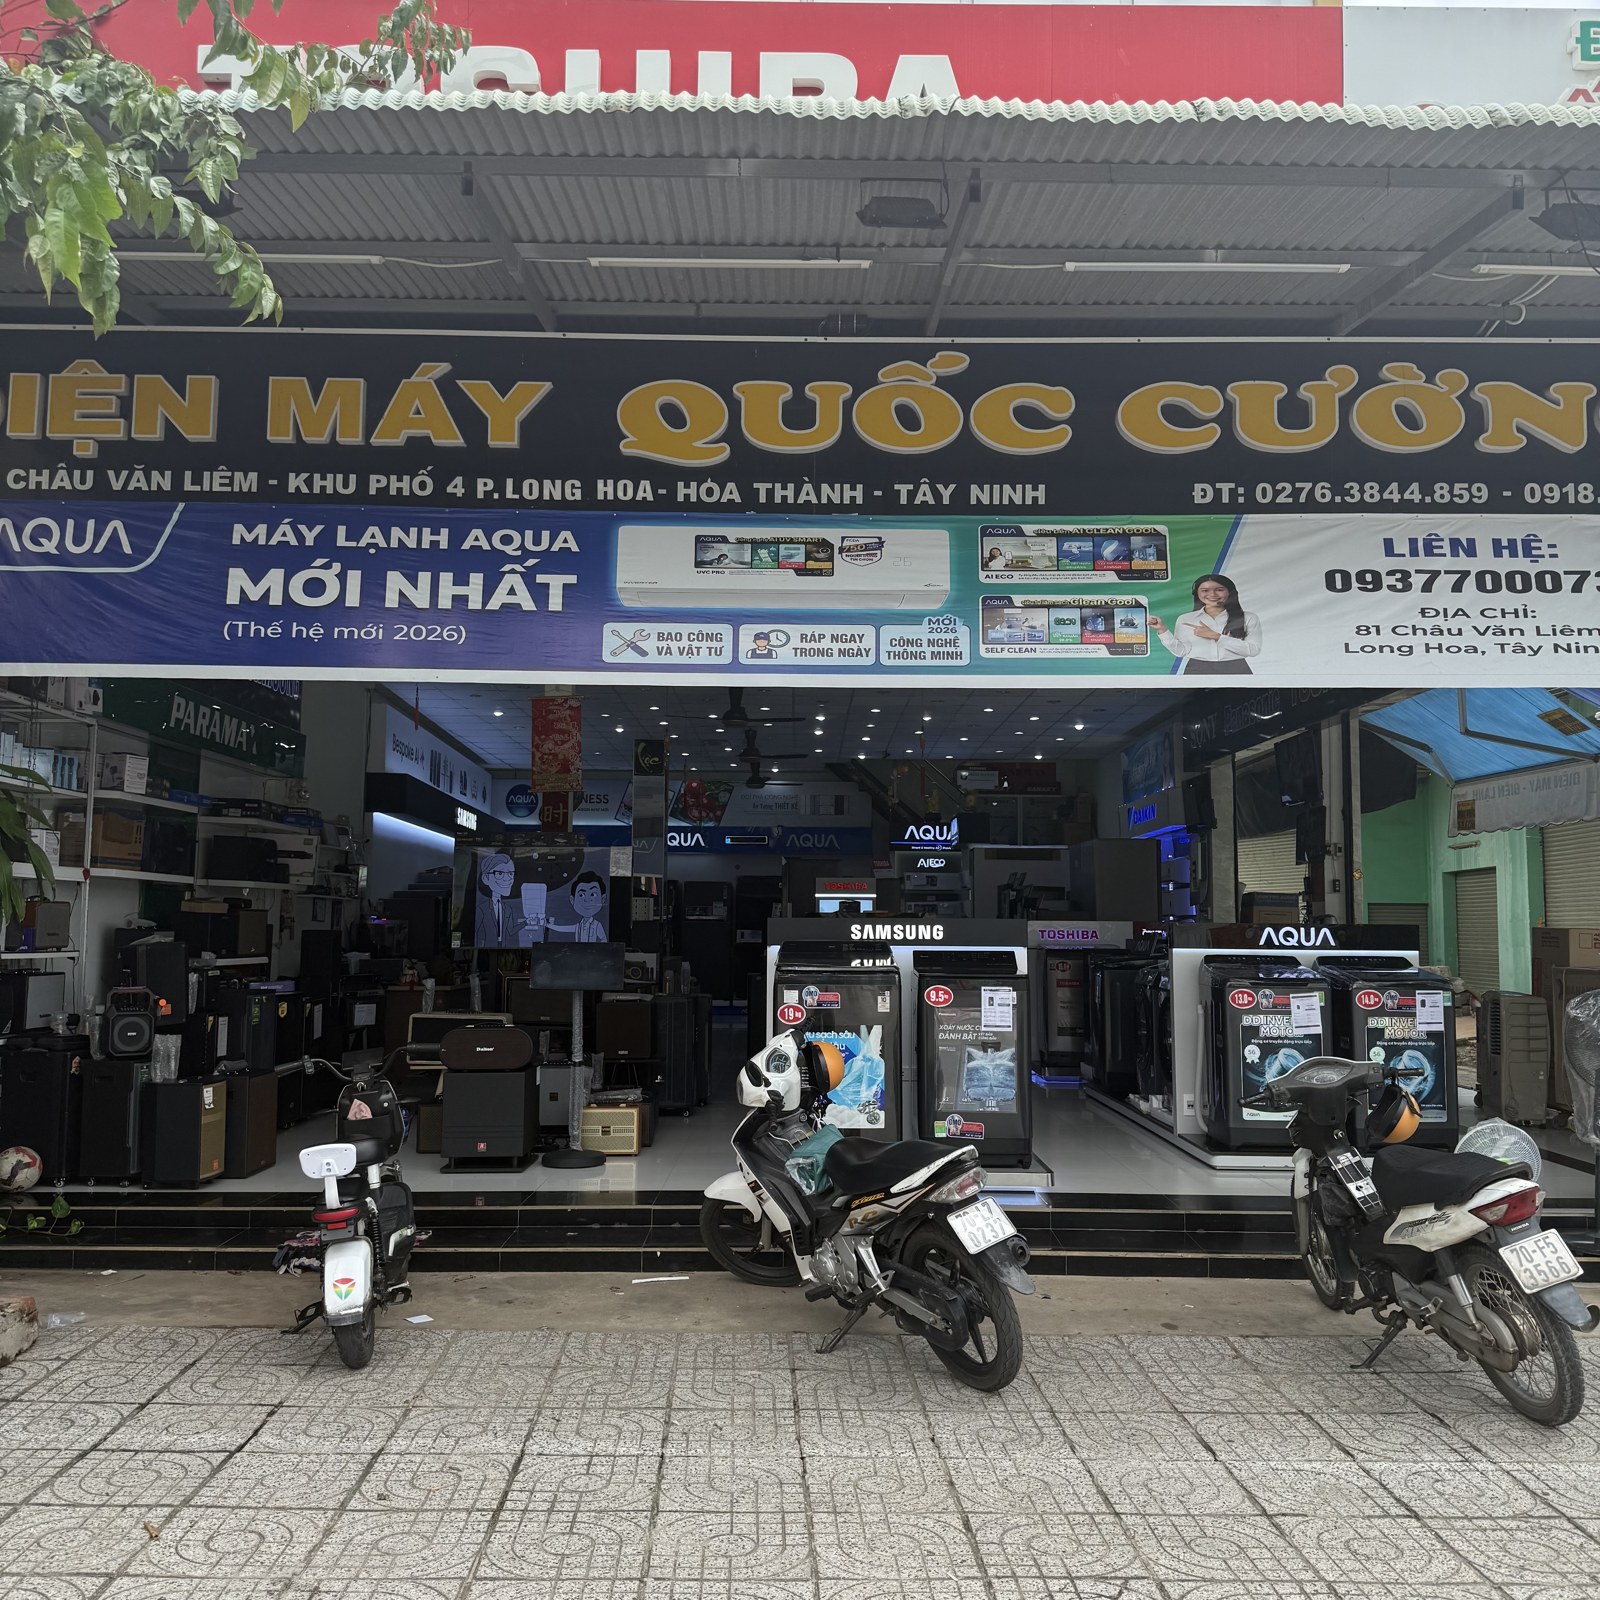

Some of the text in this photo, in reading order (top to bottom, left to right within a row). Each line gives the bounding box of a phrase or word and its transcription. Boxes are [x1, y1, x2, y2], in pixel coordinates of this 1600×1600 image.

[0, 351, 1600, 467] IỆN MÁY QUỐC CƯỜN
[6, 462, 95, 491] CHÂU
[106, 464, 173, 492] VĂN
[183, 465, 259, 493] LIÊM
[288, 472, 357, 495] KHU
[368, 466, 434, 498] PHỐ
[446, 476, 465, 498] 4
[476, 478, 581, 501] P.LONG
[753, 476, 863, 505] THÀNH
[894, 478, 957, 505] TÂY
[970, 484, 1046, 505] NINH
[1192, 482, 1245, 504] ĐT:
[1255, 482, 1488, 503] 0276.3844.859
[231, 518, 580, 555] MÁY LẠNH AQUA
[1383, 532, 1559, 563] LIÊN HỆ:
[225, 558, 578, 611] MỚI NHẤT
[1324, 568, 1600, 594] 093770007
[1418, 603, 1538, 621] ĐỊA CHỈ:
[927, 615, 958, 627] MỚI
[223, 619, 467, 645] (Thế hệ mới 2026)
[656, 629, 724, 643] BAO CÔNG
[927, 626, 958, 635] 2026
[1354, 623, 1600, 637] 81 Châu Văn Liêm
[800, 631, 866, 645] RÁP NGAY
[889, 636, 961, 652] CÔNG NGHỆ
[656, 645, 725, 659] VÀ VẬT TƯ
[793, 645, 872, 659] TRONG NGÀY
[886, 648, 963, 662] THÔNG MINH
[985, 646, 1007, 654] SELF
[1011, 646, 1037, 654] CLEAN
[1344, 642, 1414, 657] Long
[1424, 642, 1487, 656] Hoa,
[1493, 642, 1544, 657] Tây
[392, 733, 415, 763] Bespoke
[508, 795, 537, 804] AQUA
[785, 833, 841, 849] AQUA
[823, 880, 869, 891] TOSHIBA
[850, 924, 945, 941] SAMSUNG
[1038, 929, 1100, 940] TOSHIBA
[1259, 926, 1337, 947] AQUA
[804, 988, 819, 997] OMO
[929, 990, 945, 1002] 9.5
[1234, 993, 1248, 1004] 13.0
[1361, 994, 1374, 1005] 14.0
[783, 1007, 794, 1021] 19
[1261, 1015, 1293, 1027] INVE
[956, 1023, 975, 1031] NƯỚC
[1387, 1016, 1417, 1028] INVE
[938, 1031, 961, 1040] ĐÁNH
[1260, 1026, 1304, 1038] MOTO
[1385, 1028, 1427, 1040] MOTOR
[967, 1217, 1006, 1248] 0237
[1511, 1221, 1530, 1232] HONDA
[1509, 1235, 1559, 1269] 70-F5
[1523, 1256, 1572, 1288] 3566
